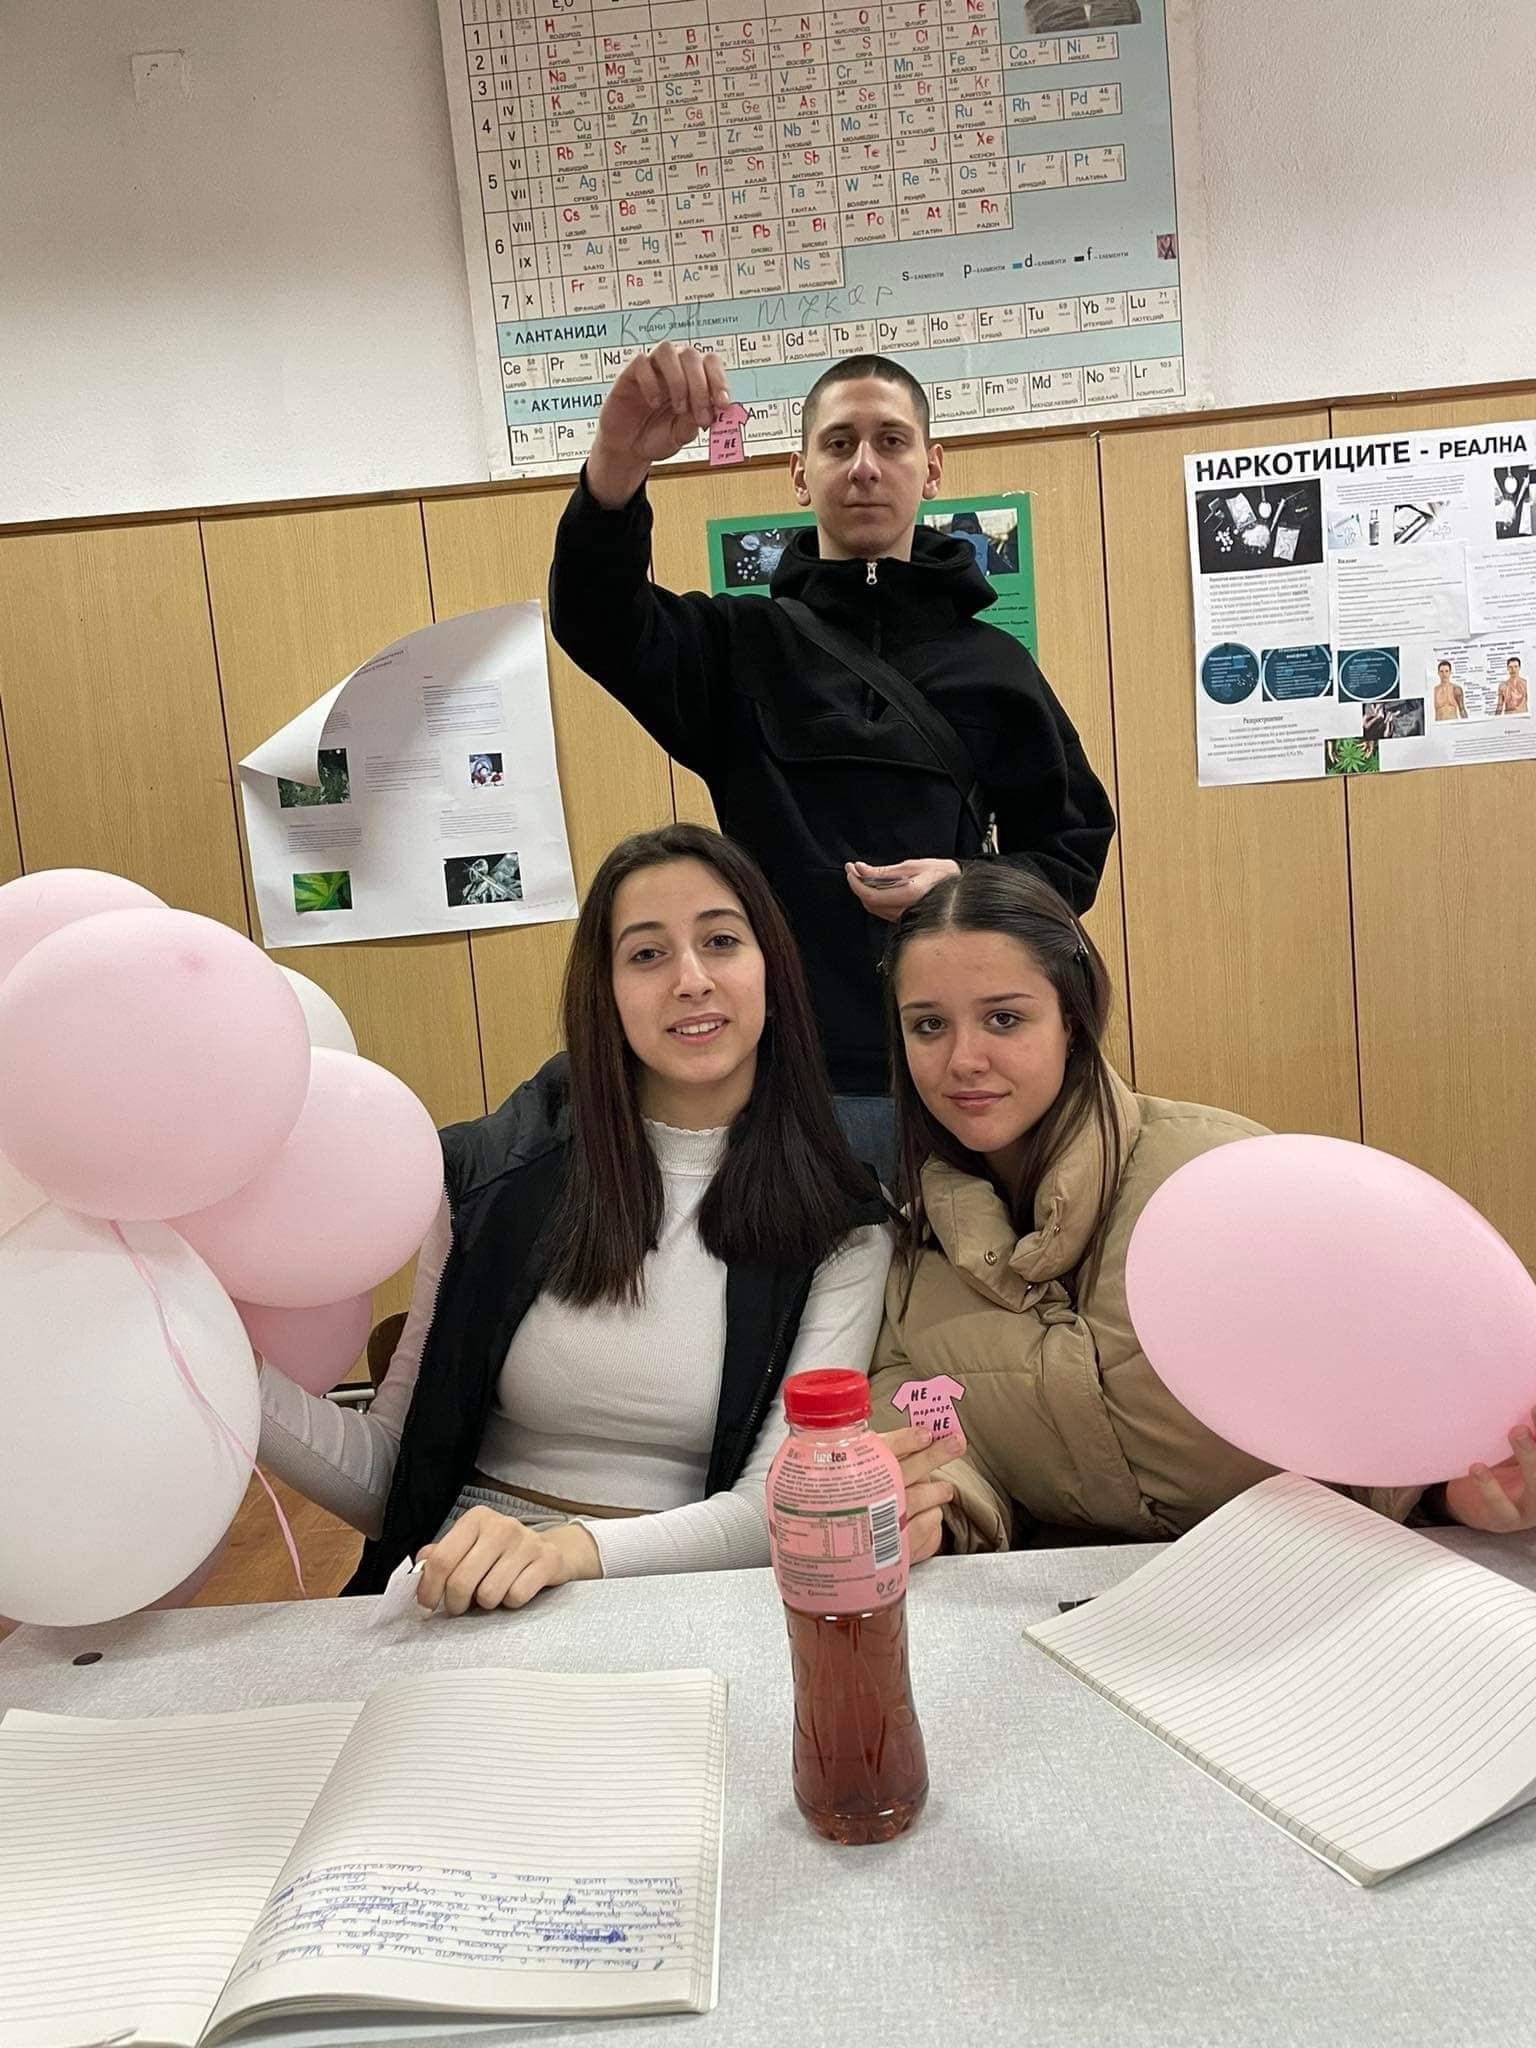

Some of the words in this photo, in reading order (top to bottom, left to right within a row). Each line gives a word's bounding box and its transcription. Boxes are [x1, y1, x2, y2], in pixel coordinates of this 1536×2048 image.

[918, 3, 926, 18] F
[966, 0, 984, 12] Ne
[859, 10, 868, 24] O
[545, 19, 555, 32] H
[743, 23, 752, 37] C
[801, 18, 810, 31] N
[971, 24, 986, 38] Ar
[474, 30, 480, 44] 1
[687, 29, 696, 43] B
[863, 36, 871, 49] S
[916, 30, 928, 43] Cl
[603, 38, 621, 51] Be
[803, 43, 812, 56] P
[1067, 40, 1080, 53] Ni
[547, 45, 557, 58] Li
[742, 49, 755, 63] Si
[1010, 46, 1027, 59] Co
[475, 56, 485, 70] 2
[501, 55, 507, 64] II
[685, 55, 698, 68] Al
[894, 58, 913, 72] Mn
[950, 53, 965, 66] Fe
[549, 70, 566, 82] Na
[605, 63, 625, 77] Mg
[837, 65, 851, 79] Cr
[722, 77, 735, 90] Ti
[780, 71, 788, 85] V
[478, 81, 487, 95] 3
[501, 80, 512, 91] III
[665, 83, 682, 96] Sc
[917, 81, 932, 95] Br
[607, 90, 623, 104] Ca
[859, 88, 875, 102] Se
[1071, 91, 1088, 105] Pd
[551, 96, 561, 110] K
[742, 101, 760, 113] Ge
[800, 96, 816, 109] As
[1012, 98, 1030, 112] Rh
[503, 105, 513, 116] IV
[955, 104, 972, 118] Ru
[632, 113, 648, 126] Zn
[900, 111, 914, 124] Tc
[483, 119, 491, 133] 4
[574, 118, 591, 131] Cu
[783, 123, 801, 137] Nb
[841, 118, 860, 131] Mo
[508, 132, 515, 141] V
[670, 135, 678, 148] Y
[727, 129, 741, 143] Zr
[977, 132, 994, 146] Xe
[614, 141, 626, 155] Sr
[930, 137, 937, 151] J
[557, 146, 573, 160] Rb
[804, 151, 820, 165] Sb
[864, 145, 880, 158] Te
[510, 159, 520, 169] VI
[747, 157, 764, 171] Sn
[1017, 160, 1025, 173] Ir
[1074, 153, 1089, 167] Pt
[635, 168, 652, 182] Cd
[696, 163, 708, 177] In
[960, 166, 977, 180] Os
[489, 174, 497, 189] 5
[580, 175, 596, 191] Ag
[845, 178, 859, 192] W
[903, 172, 919, 186] Re
[511, 189, 526, 200] VII
[731, 190, 747, 204] Hf
[789, 185, 805, 198] Ta
[619, 200, 636, 217] Ba
[927, 207, 941, 219] At
[980, 200, 998, 213] Rn
[563, 208, 580, 222] Cs
[867, 212, 884, 226] Po
[513, 221, 531, 232] VIII
[753, 225, 770, 238] Pb
[813, 218, 826, 232] Bi
[495, 240, 504, 254] 6
[586, 242, 603, 255] Au
[642, 237, 659, 253] Hg
[519, 257, 531, 268] IX
[793, 257, 810, 270] Ns
[737, 263, 755, 276] Ku
[571, 280, 585, 293] Fr
[627, 274, 643, 287] Ra
[502, 295, 509, 309] 7
[526, 295, 533, 305] X
[1131, 296, 1146, 309] Lu
[1028, 308, 1043, 320] Tu
[1083, 301, 1099, 315] Yb
[931, 318, 948, 331] Ho
[980, 313, 993, 326] Er
[515, 324, 607, 344] ЛАНТАНИДИ
[832, 328, 849, 341] Tb
[879, 324, 898, 340] Dy
[740, 339, 756, 351] Eu
[786, 333, 804, 346] Gd
[551, 358, 564, 370] Pr
[604, 352, 620, 366] Nd
[504, 362, 520, 375] Ce
[1134, 365, 1147, 378] Lr
[1032, 375, 1051, 390] Md
[1087, 371, 1104, 383] No
[936, 387, 951, 400] Es
[985, 382, 1004, 395] Fm
[531, 394, 606, 412] АКТИНИД
[749, 408, 768, 420] Am
[512, 431, 528, 443] Th
[558, 426, 574, 439] Pa
[1196, 441, 1411, 482] НАРКОТИЦИТЕ
[1439, 435, 1527, 459] РЕАЛНА
[911, 1387, 928, 1402] НЕ
[933, 1417, 950, 1432] НЕ
